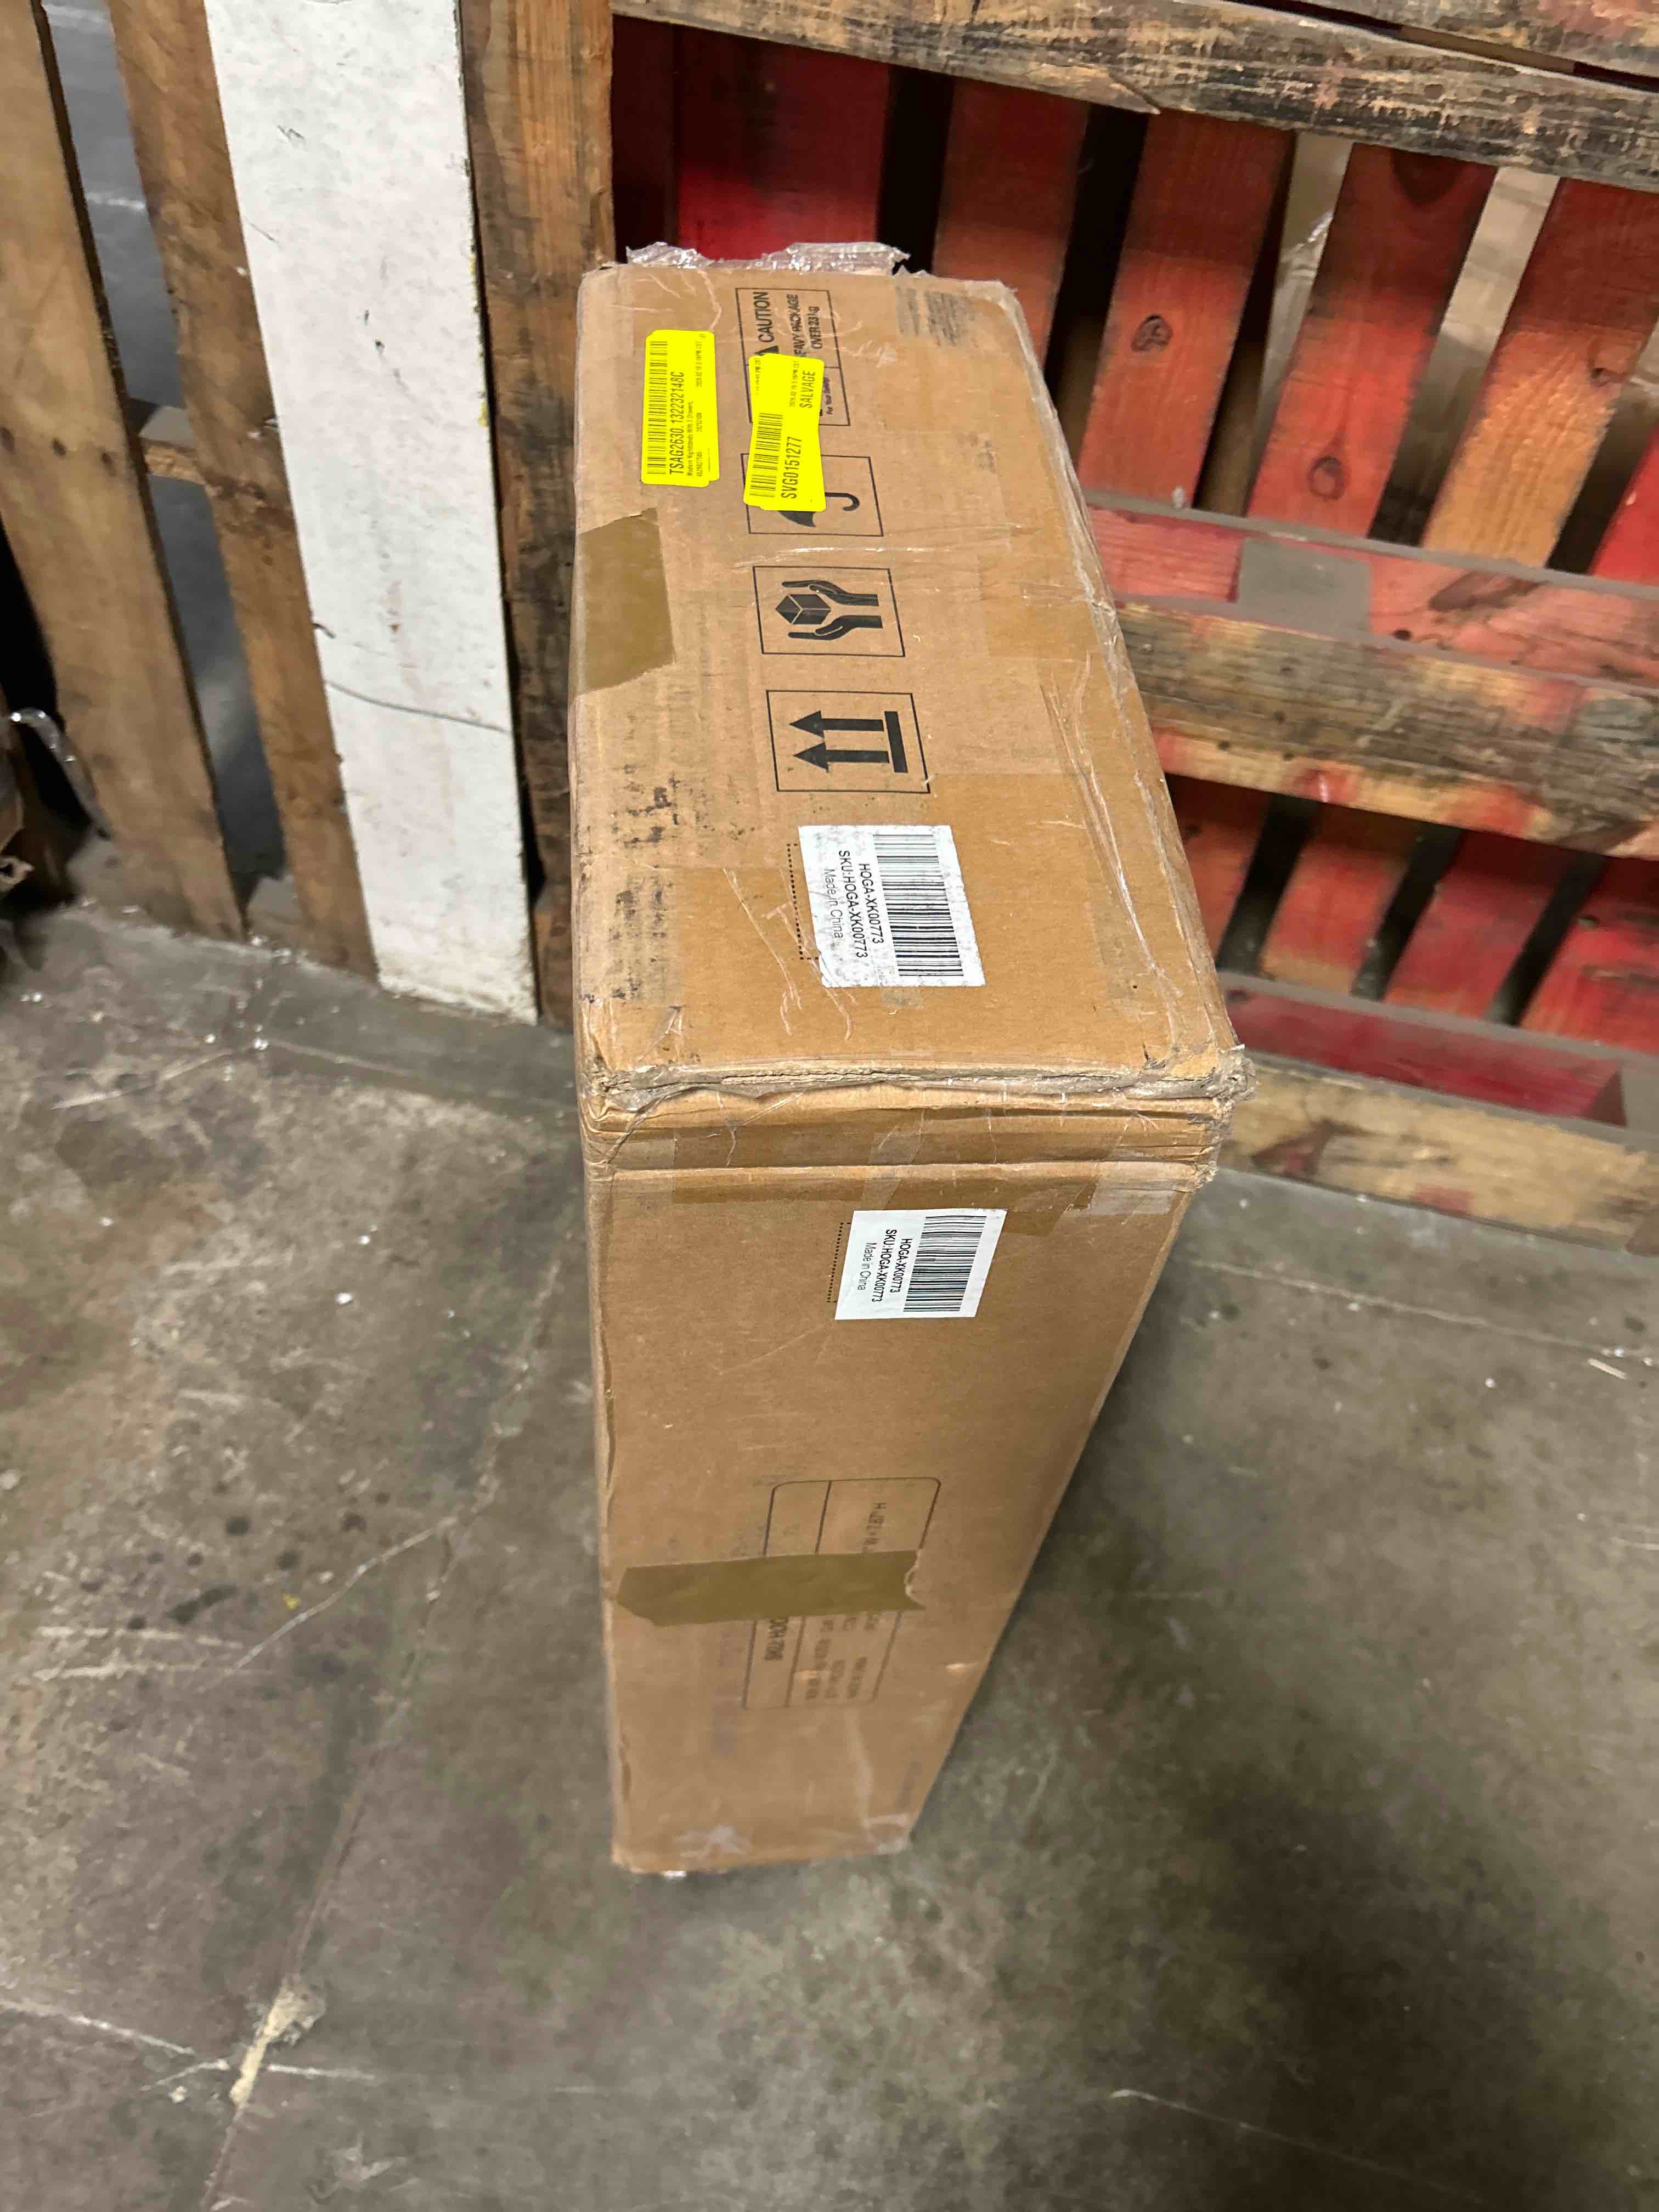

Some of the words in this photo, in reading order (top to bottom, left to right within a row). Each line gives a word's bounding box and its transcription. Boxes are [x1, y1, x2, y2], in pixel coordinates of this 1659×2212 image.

[753, 292, 775, 342] CAUTION
[786, 294, 803, 332] PACKAGE
[799, 370, 815, 408] SALVAGE
[781, 437, 802, 499] SVG0151277
[823, 869, 836, 895] Made
[829, 898, 838, 906] in
[838, 850, 868, 958] SKU:HOGA-XK00773
[858, 864, 884, 944] HOGA-XK00773
[831, 909, 843, 939] China
[862, 1243, 877, 1262] Made
[872, 1229, 898, 1302] SKU:HOGA-XK00773
[890, 1238, 913, 1293] HOGA-XK00773
[857, 1271, 871, 1290] China
